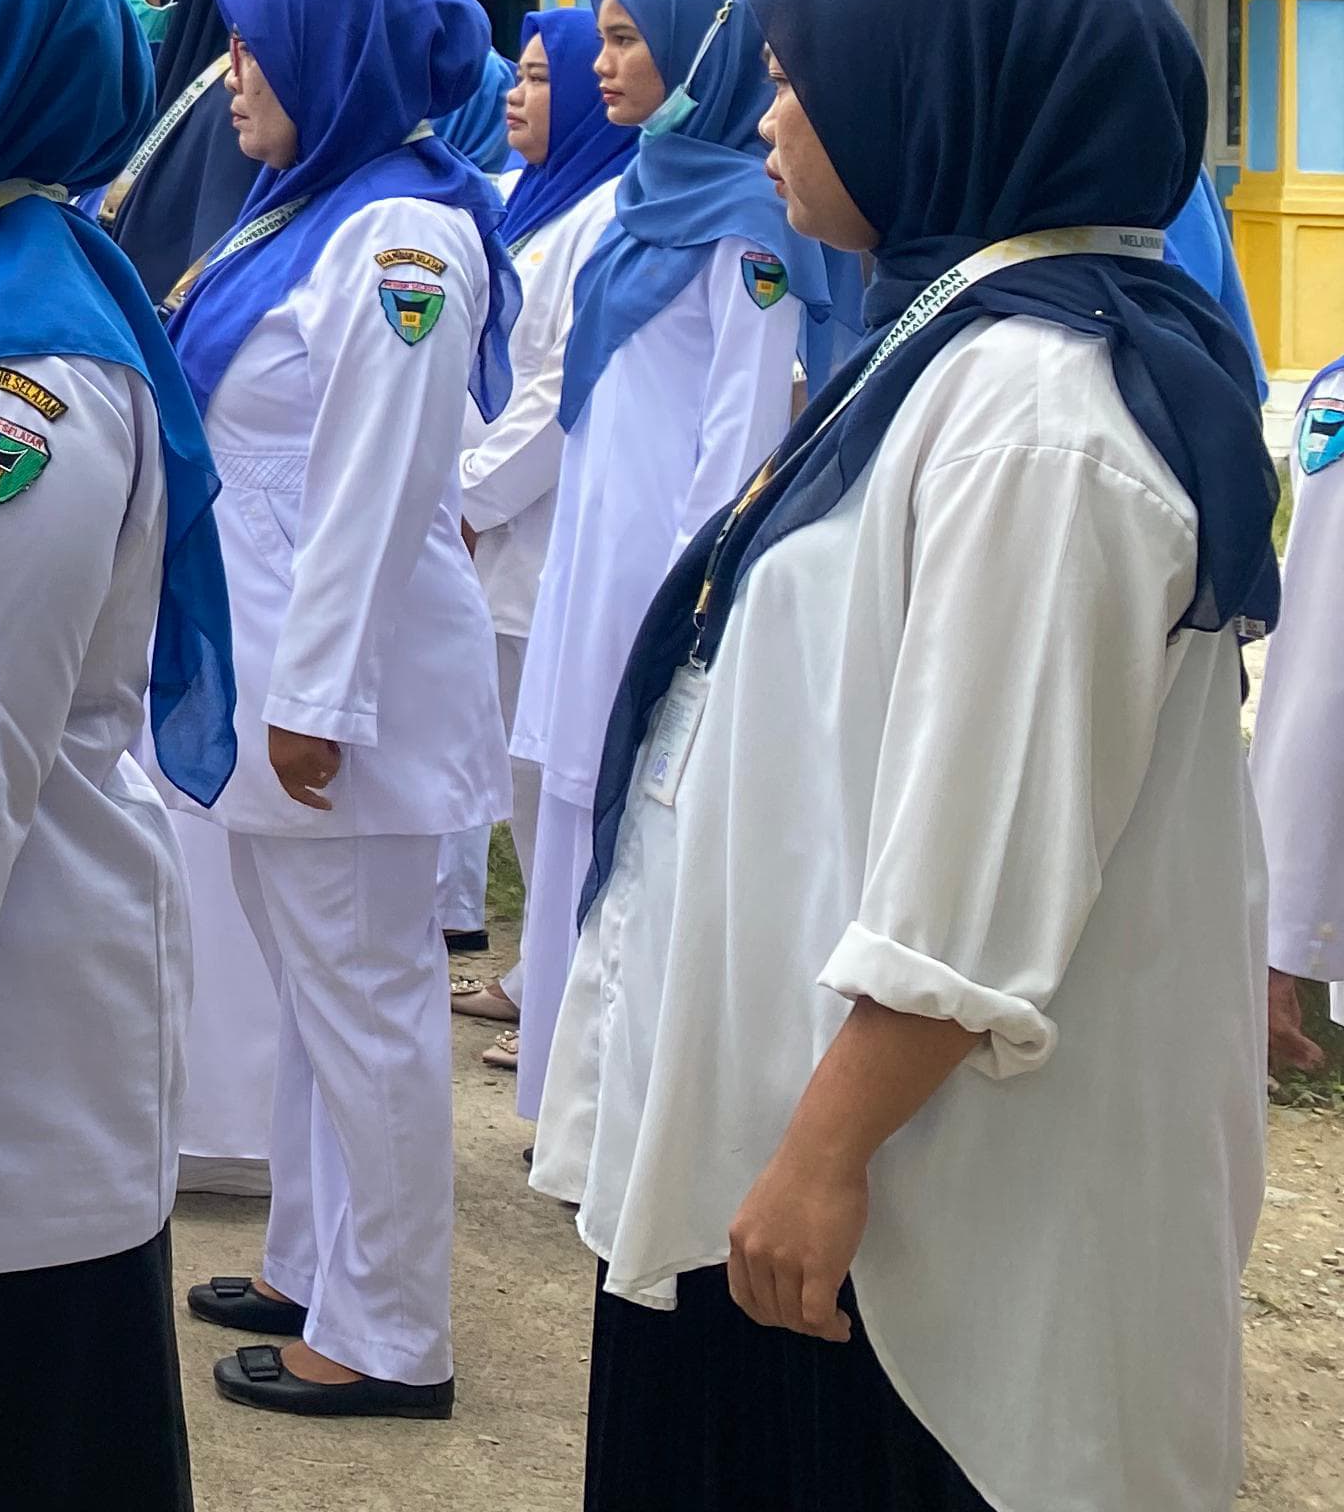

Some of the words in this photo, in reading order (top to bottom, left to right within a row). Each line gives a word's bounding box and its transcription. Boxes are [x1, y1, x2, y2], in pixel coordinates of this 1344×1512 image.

[147, 109, 183, 151] PUSKESMAS
[131, 151, 150, 176] TAPAN
[233, 215, 289, 248] PUSKESMAS
[904, 306, 934, 338] BALAI
[934, 276, 969, 309] TAPAN
[914, 268, 962, 311] TAPAN
[11, 375, 62, 416] SELATAN
[2, 422, 44, 449] SELATAN
